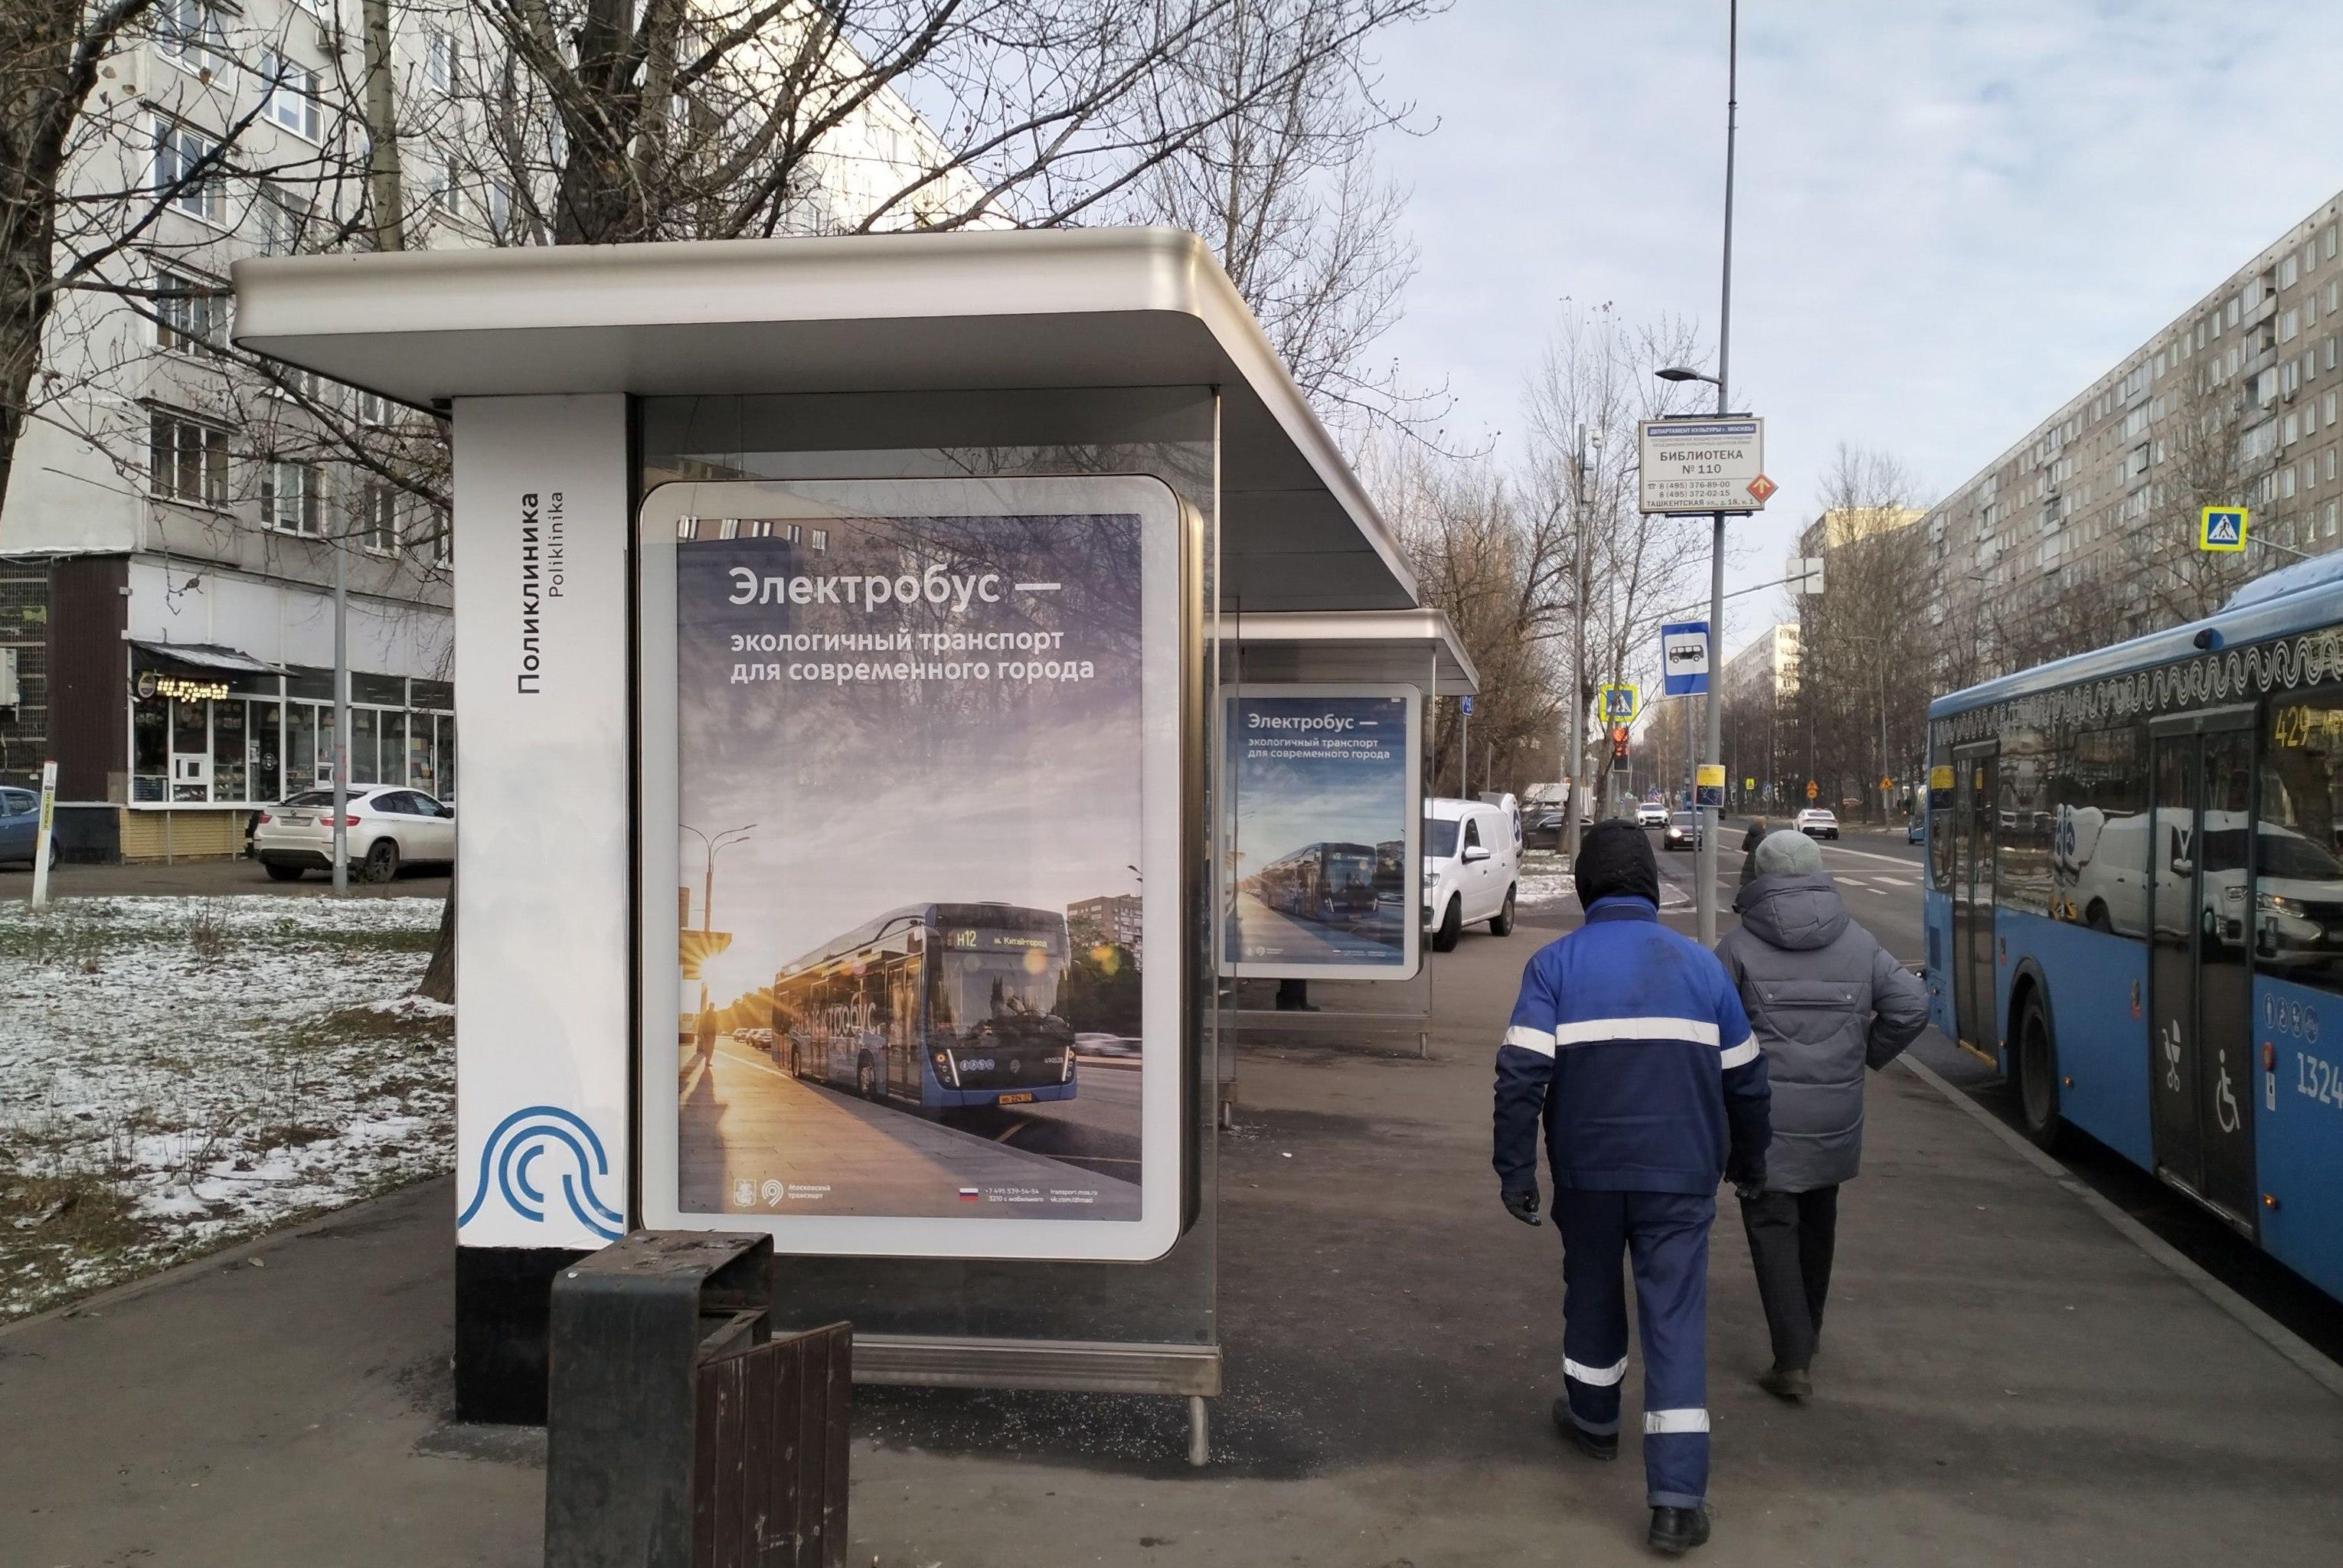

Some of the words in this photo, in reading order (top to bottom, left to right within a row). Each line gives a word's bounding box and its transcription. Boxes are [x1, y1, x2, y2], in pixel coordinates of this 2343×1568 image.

[1660, 450, 1743, 461] БИБЛИОТЕКА
[1698, 464, 1721, 473] 110
[547, 492, 564, 597] Poliklinika
[518, 493, 540, 694] Поликлиника
[728, 564, 1001, 612] Электробус
[730, 628, 911, 652] экологичный
[920, 630, 1064, 655] транспорт
[730, 661, 780, 684] для
[789, 660, 990, 685] современного
[998, 658, 1095, 683] города
[1247, 713, 1354, 733] Электробус
[2276, 705, 2310, 747] 429
[1248, 737, 1319, 747] экологичный
[1322, 740, 1379, 749] транспорт
[1248, 750, 1268, 759] для
[1271, 750, 1348, 760] современного
[1352, 750, 1390, 760] города
[1004, 937, 1047, 948] Китай-город
